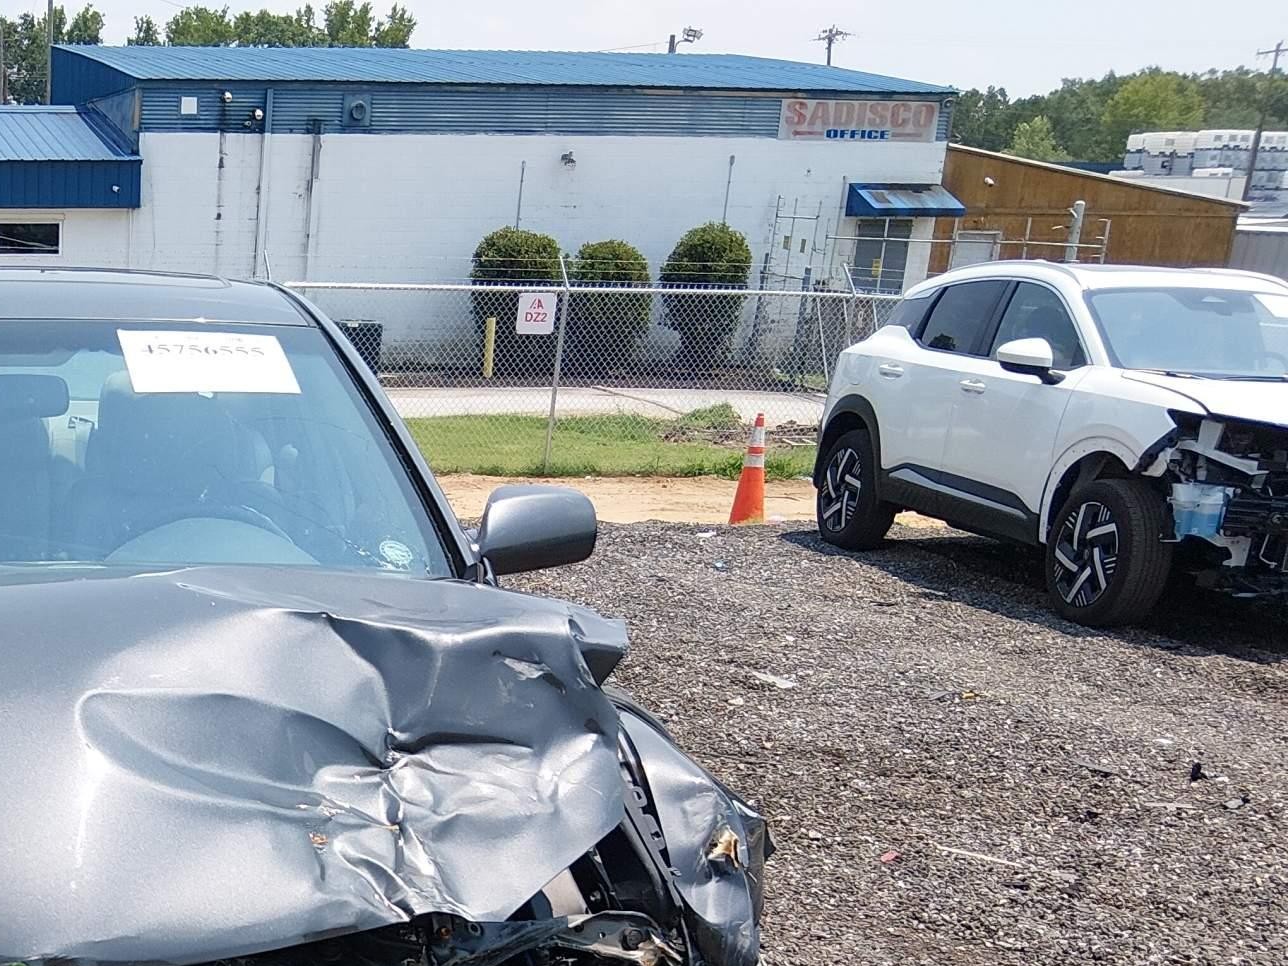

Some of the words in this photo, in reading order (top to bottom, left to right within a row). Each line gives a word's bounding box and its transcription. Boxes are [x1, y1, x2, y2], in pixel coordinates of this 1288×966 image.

[785, 101, 935, 128] SADISCO
[825, 129, 891, 140] OFFICE
[524, 311, 548, 323] DZ2
